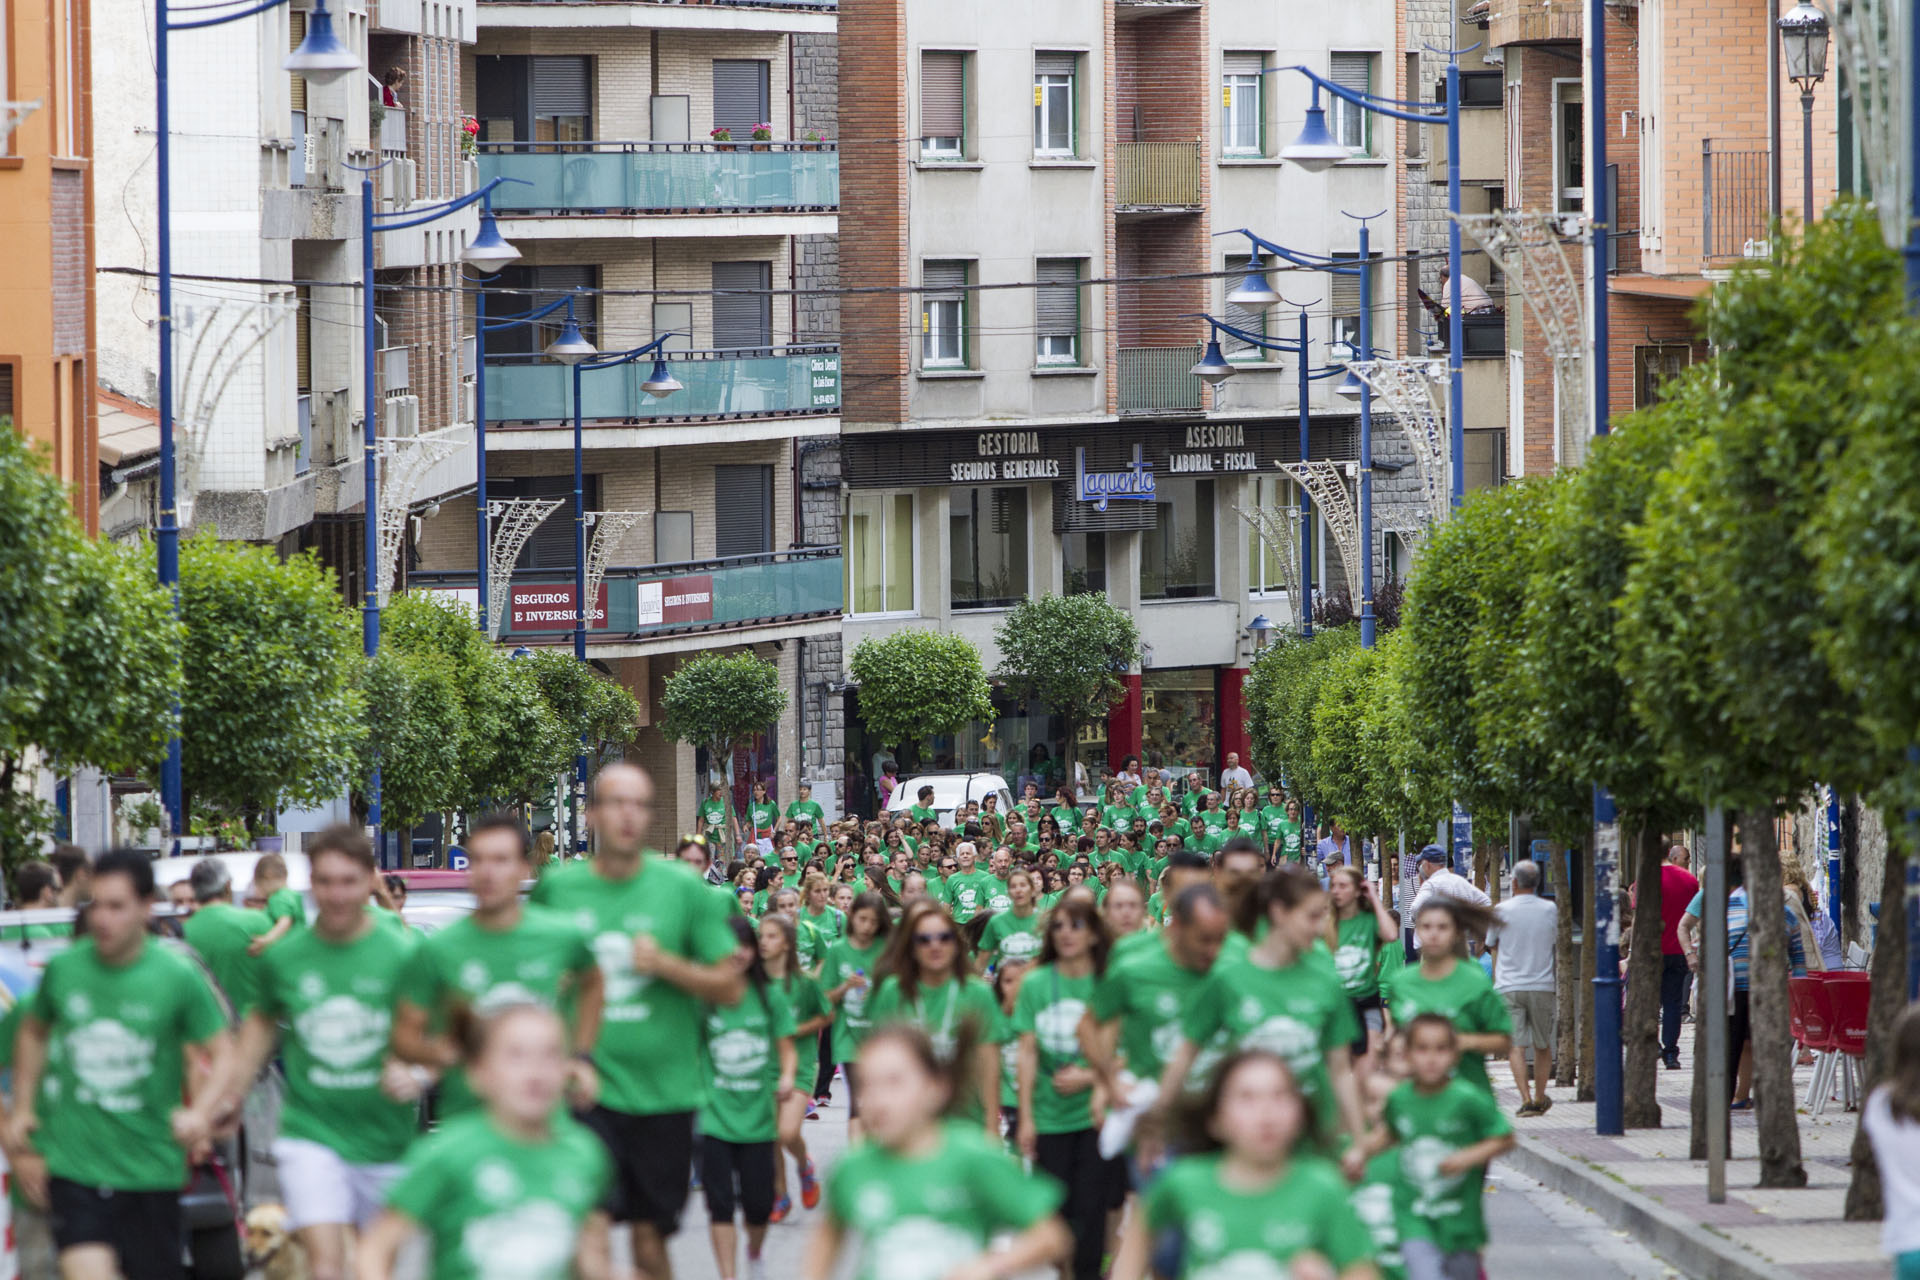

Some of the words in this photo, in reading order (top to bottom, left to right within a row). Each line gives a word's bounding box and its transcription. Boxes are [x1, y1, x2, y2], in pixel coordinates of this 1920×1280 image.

[978, 432, 1039, 456] GESTORIA
[1185, 424, 1245, 448] ASESORIA
[950, 461, 996, 481] SEGUROS
[1002, 459, 1059, 479] GENERALES
[1169, 453, 1213, 472] LABORAL
[1223, 452, 1257, 471] FISCAL
[1075, 443, 1156, 511] Laguarta
[514, 593, 569, 605] SEGUROS
[514, 611, 523, 622] E
[453, 856, 469, 870] P
